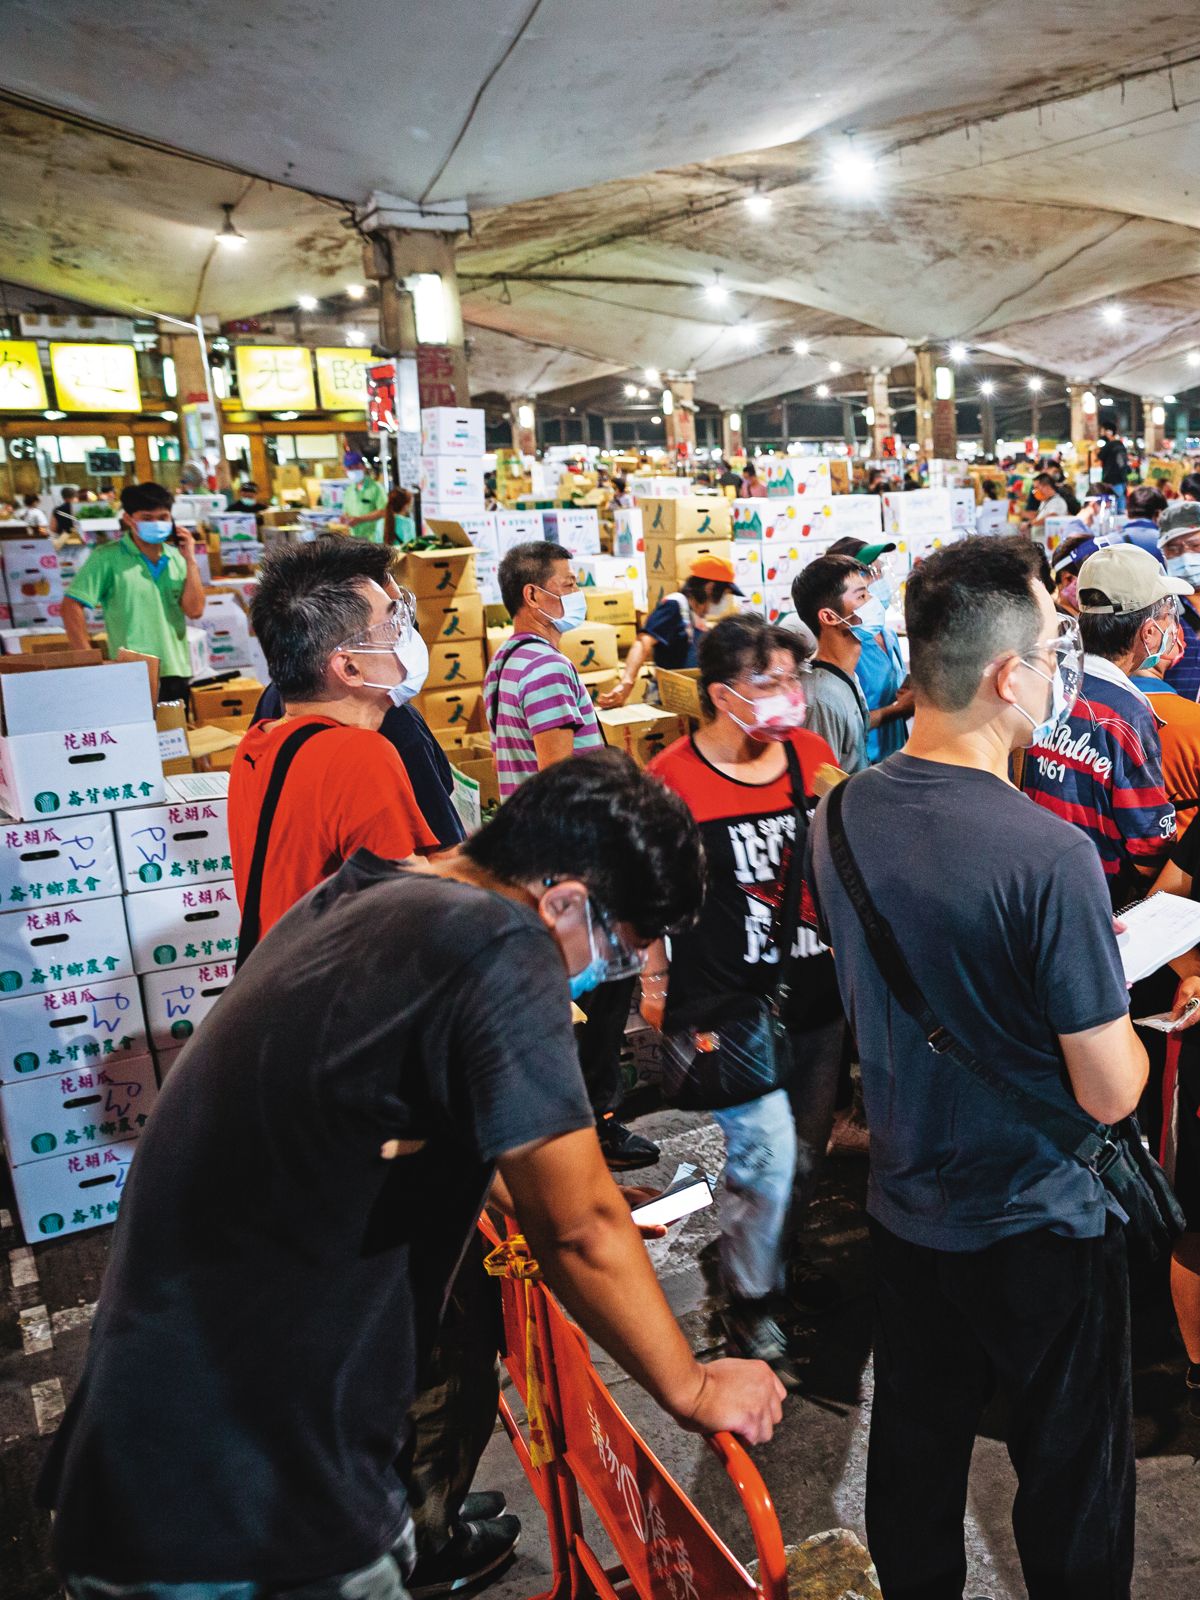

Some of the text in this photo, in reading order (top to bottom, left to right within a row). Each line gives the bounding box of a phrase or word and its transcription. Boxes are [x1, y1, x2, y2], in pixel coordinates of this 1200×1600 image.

[256, 356, 305, 392] 光
[64, 730, 118, 751] 花胡瓜
[1036, 755, 1066, 783] 1961
[68, 781, 155, 807] 崙背鄉農會
[168, 805, 219, 825] 花胡瓜
[5, 828, 62, 849] 花胡瓜
[9, 876, 101, 903] 崙背鄉農會
[182, 887, 232, 909] 花胡瓜
[26, 909, 83, 932] 花胡瓜
[183, 936, 240, 960] 崙背鄉
[29, 955, 122, 985] 崙背鄉農會
[43, 988, 98, 1011] 花胡瓜
[47, 1035, 137, 1065] 崙背鄉農會
[60, 1071, 115, 1094] 花胡瓜
[68, 1150, 121, 1173] 花胡瓜
